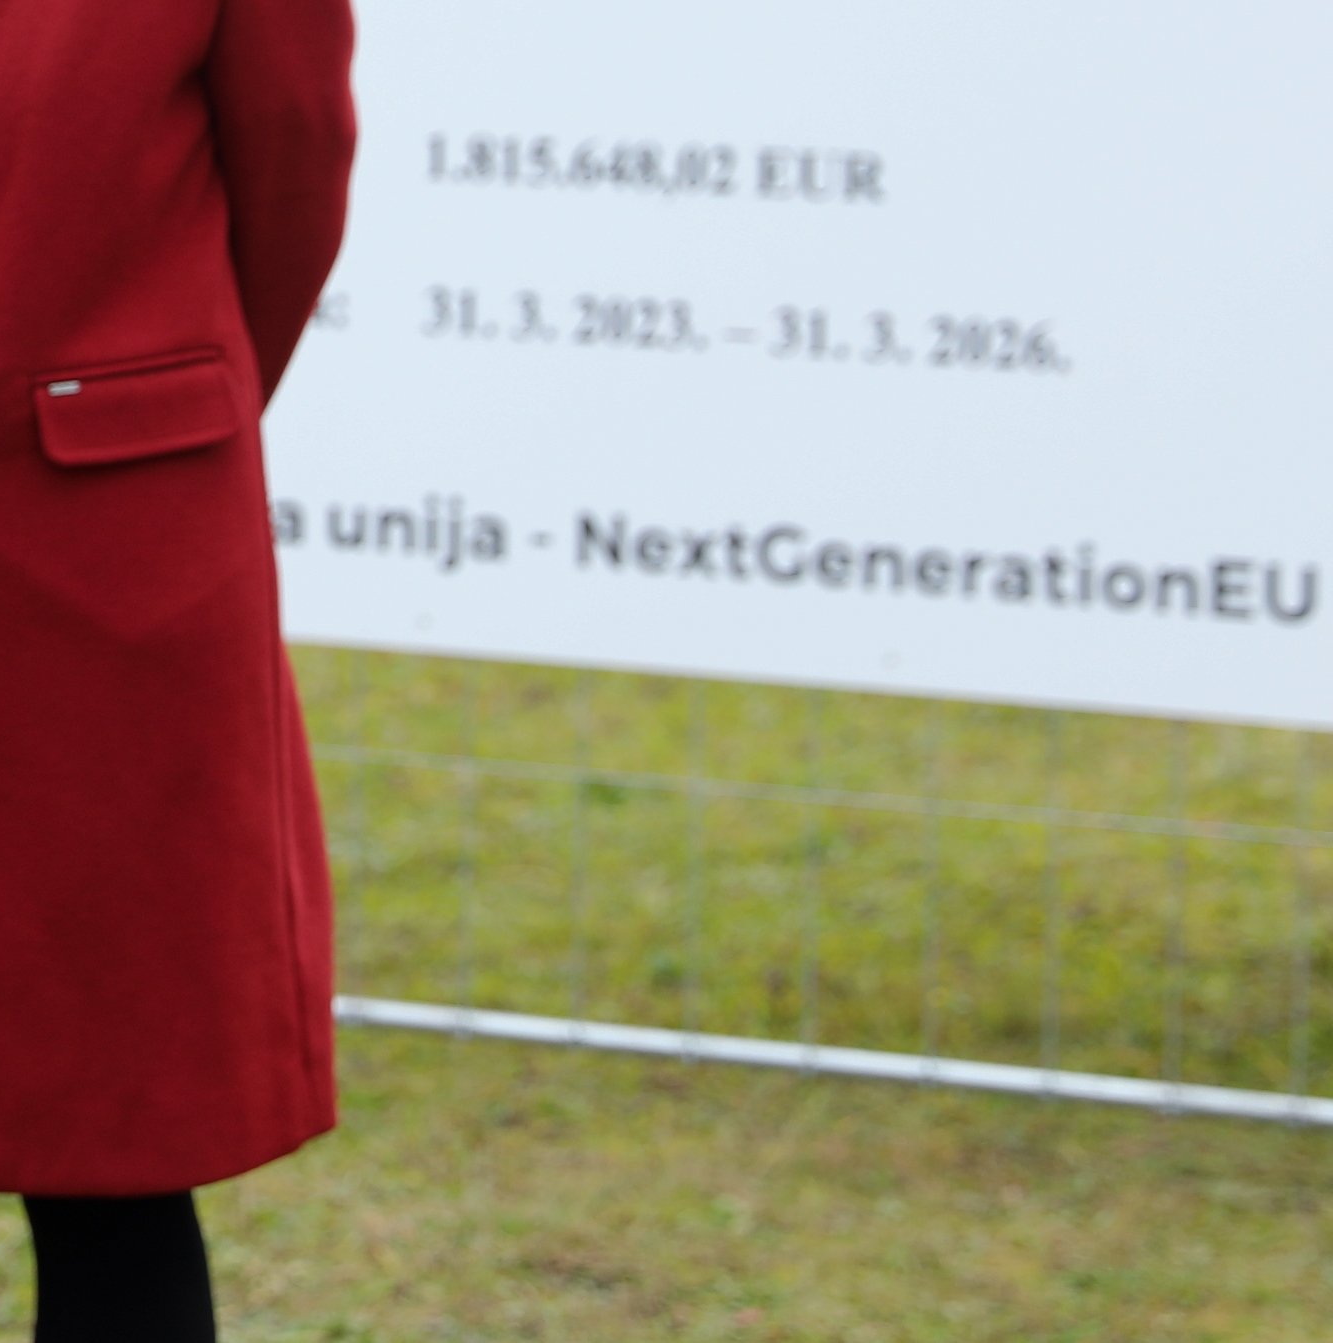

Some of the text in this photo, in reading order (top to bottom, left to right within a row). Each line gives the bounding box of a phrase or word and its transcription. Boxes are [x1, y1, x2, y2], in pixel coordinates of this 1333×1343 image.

[756, 145, 888, 204] EUR
[573, 294, 710, 352] 2023.
[930, 313, 1073, 375] 2026.
[327, 496, 507, 574] unija
[574, 508, 1319, 625] NextGenerationEU
